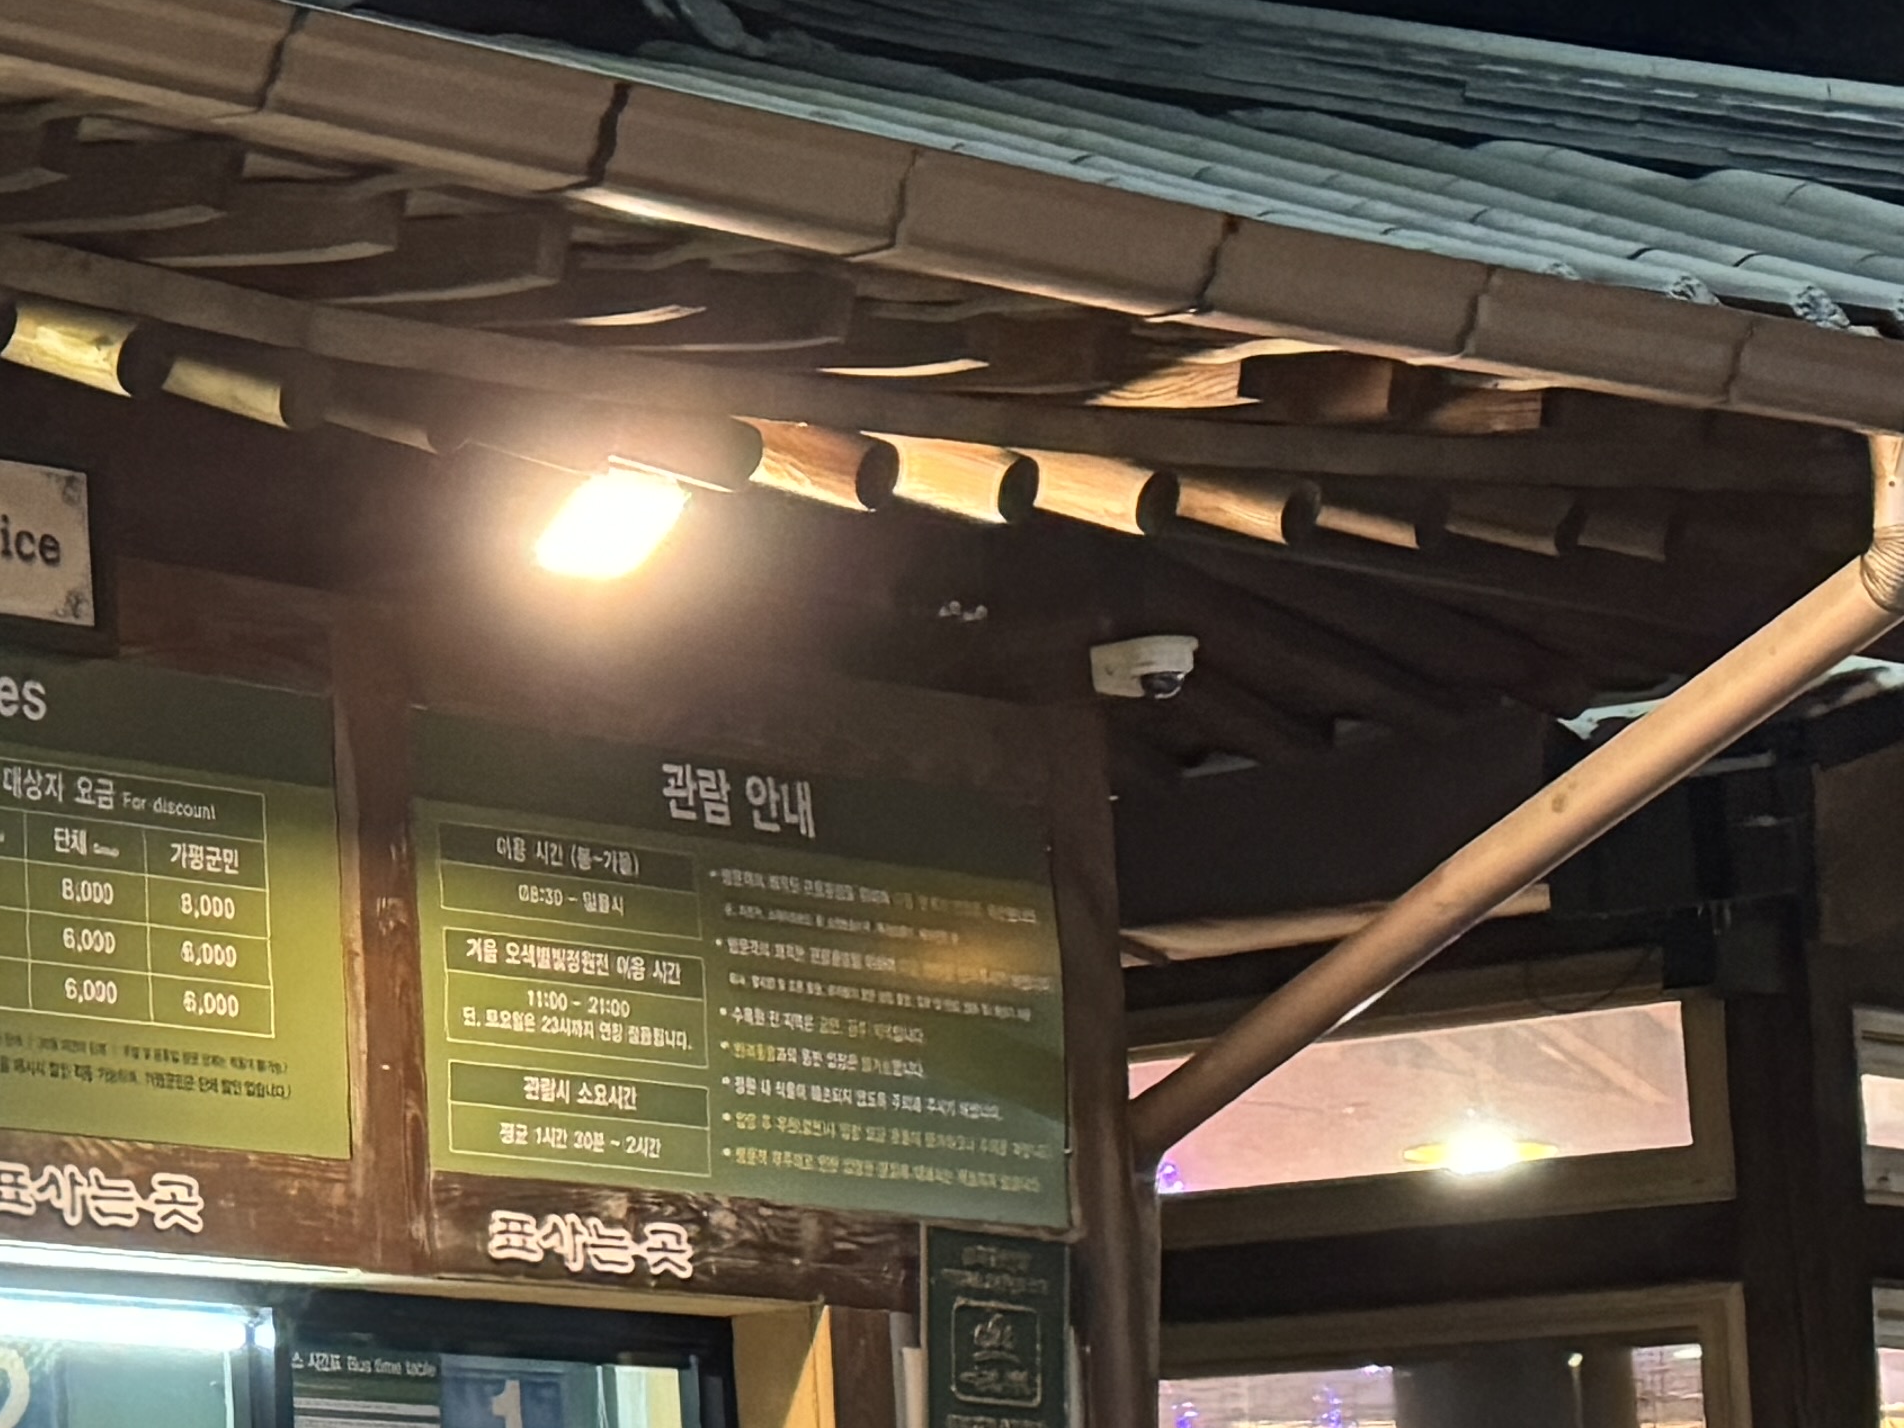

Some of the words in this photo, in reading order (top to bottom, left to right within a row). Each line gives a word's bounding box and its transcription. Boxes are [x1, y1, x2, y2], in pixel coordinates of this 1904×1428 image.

[122, 791, 146, 810] For
[152, 796, 215, 820] discount
[662, 763, 730, 826] 관람
[746, 775, 815, 838] 안내
[53, 827, 87, 855] 단체
[180, 892, 235, 919] 8,000
[64, 977, 117, 1004] 6,000
[527, 989, 567, 1011] 11:00
[587, 996, 630, 1018] 21:00
[291, 1351, 304, 1368] 스
